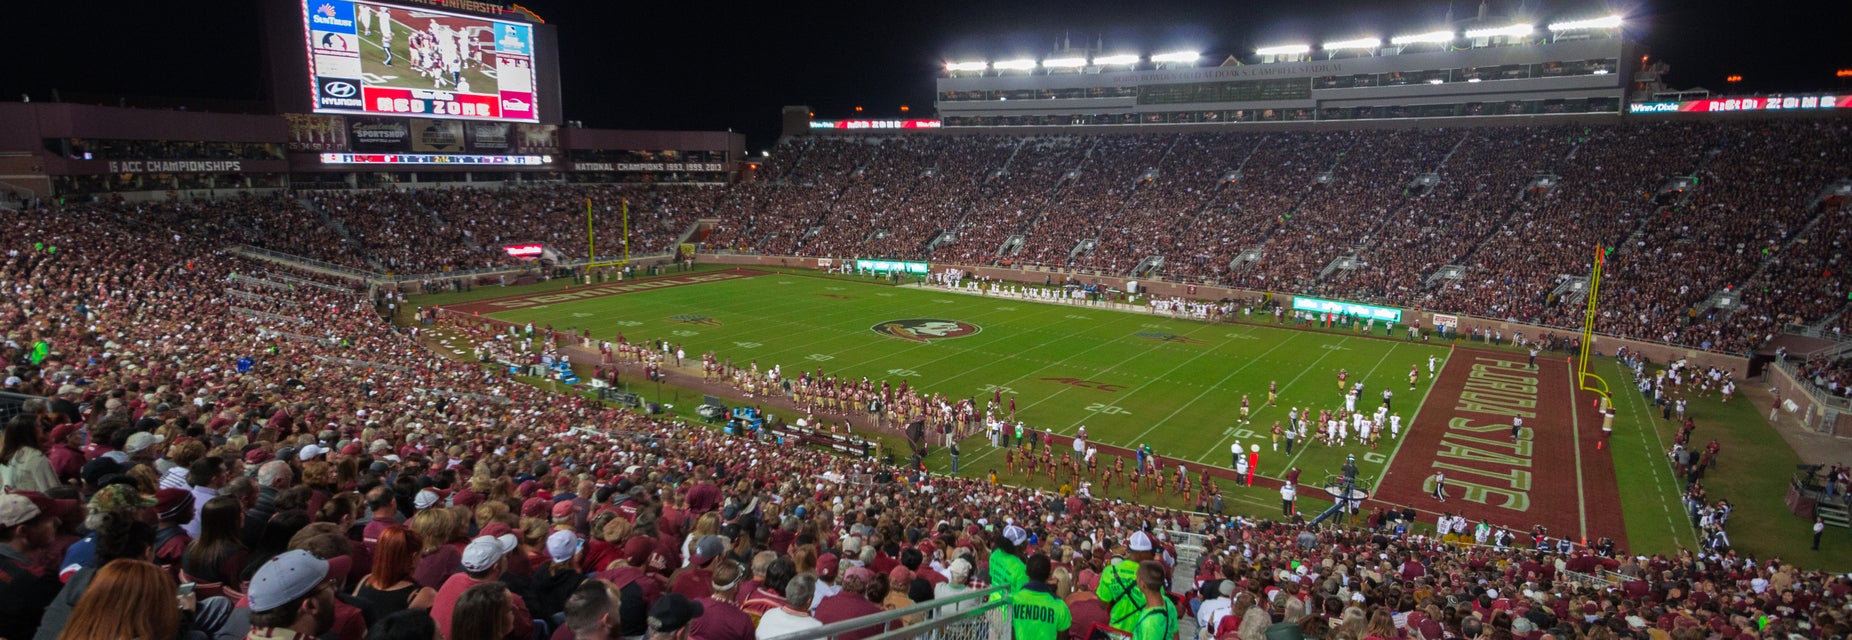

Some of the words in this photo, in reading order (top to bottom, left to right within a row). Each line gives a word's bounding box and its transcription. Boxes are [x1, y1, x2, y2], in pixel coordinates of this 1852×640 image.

[442, 0, 503, 15] UNIVERSITY
[1300, 63, 1342, 73] STADIUM
[377, 97, 425, 113] RED
[432, 101, 490, 116] ZONE
[1709, 98, 1758, 112] RED
[1766, 96, 1836, 109] ZONE
[122, 161, 143, 172] ACC
[147, 161, 241, 172] CHAMPIONSHIPS
[575, 162, 614, 171] NATIONAL
[617, 162, 664, 171] CHAMPIONS
[706, 163, 722, 171] 2013
[1454, 357, 1540, 418] FLORIDA
[1084, 402, 1123, 415] 20
[1222, 426, 1254, 439] 10
[1363, 452, 1387, 464] G
[1423, 417, 1535, 512] STATE
[1013, 604, 1055, 623] VENDOR
